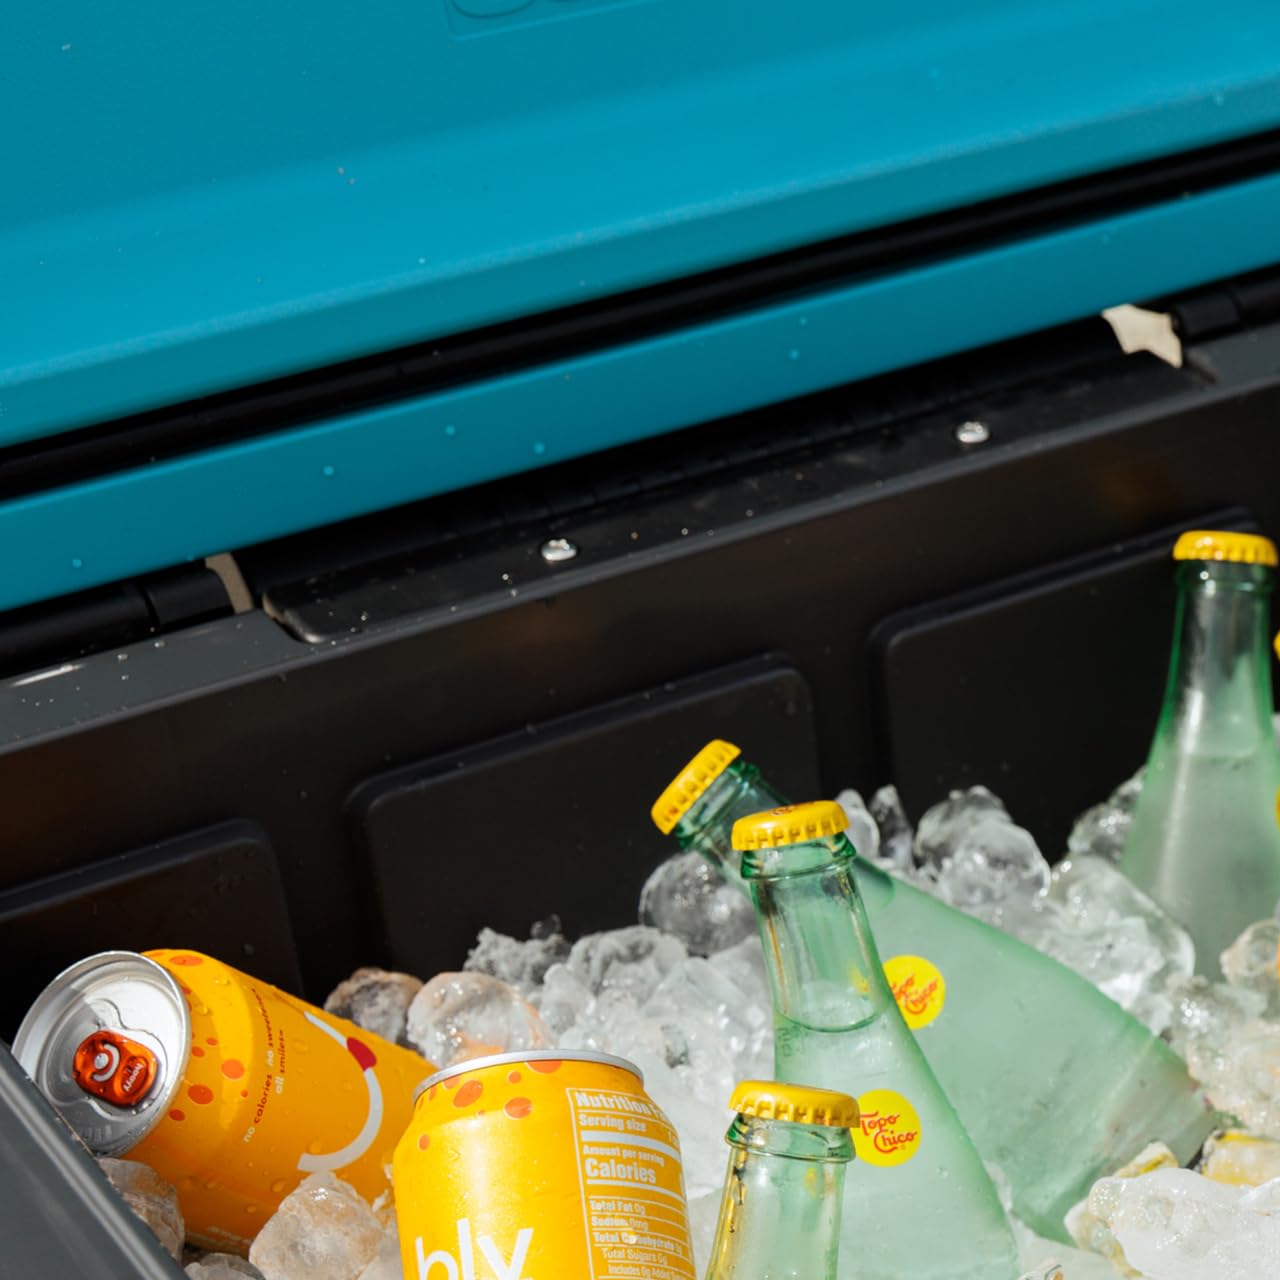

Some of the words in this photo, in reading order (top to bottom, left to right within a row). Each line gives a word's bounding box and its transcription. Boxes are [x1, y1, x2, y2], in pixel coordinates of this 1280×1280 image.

[243, 1126, 256, 1143] no
[253, 1073, 273, 1125] calories
[267, 1050, 274, 1067] no
[274, 1076, 285, 1095] all
[575, 1091, 652, 1116] Nutrition
[579, 1114, 625, 1131] Serving
[626, 1119, 647, 1132] size
[861, 1109, 901, 1137] Topo
[873, 1128, 918, 1154] Chico
[585, 1157, 657, 1184] Calories
[590, 1200, 616, 1211] Total
[602, 1247, 625, 1259] Total
